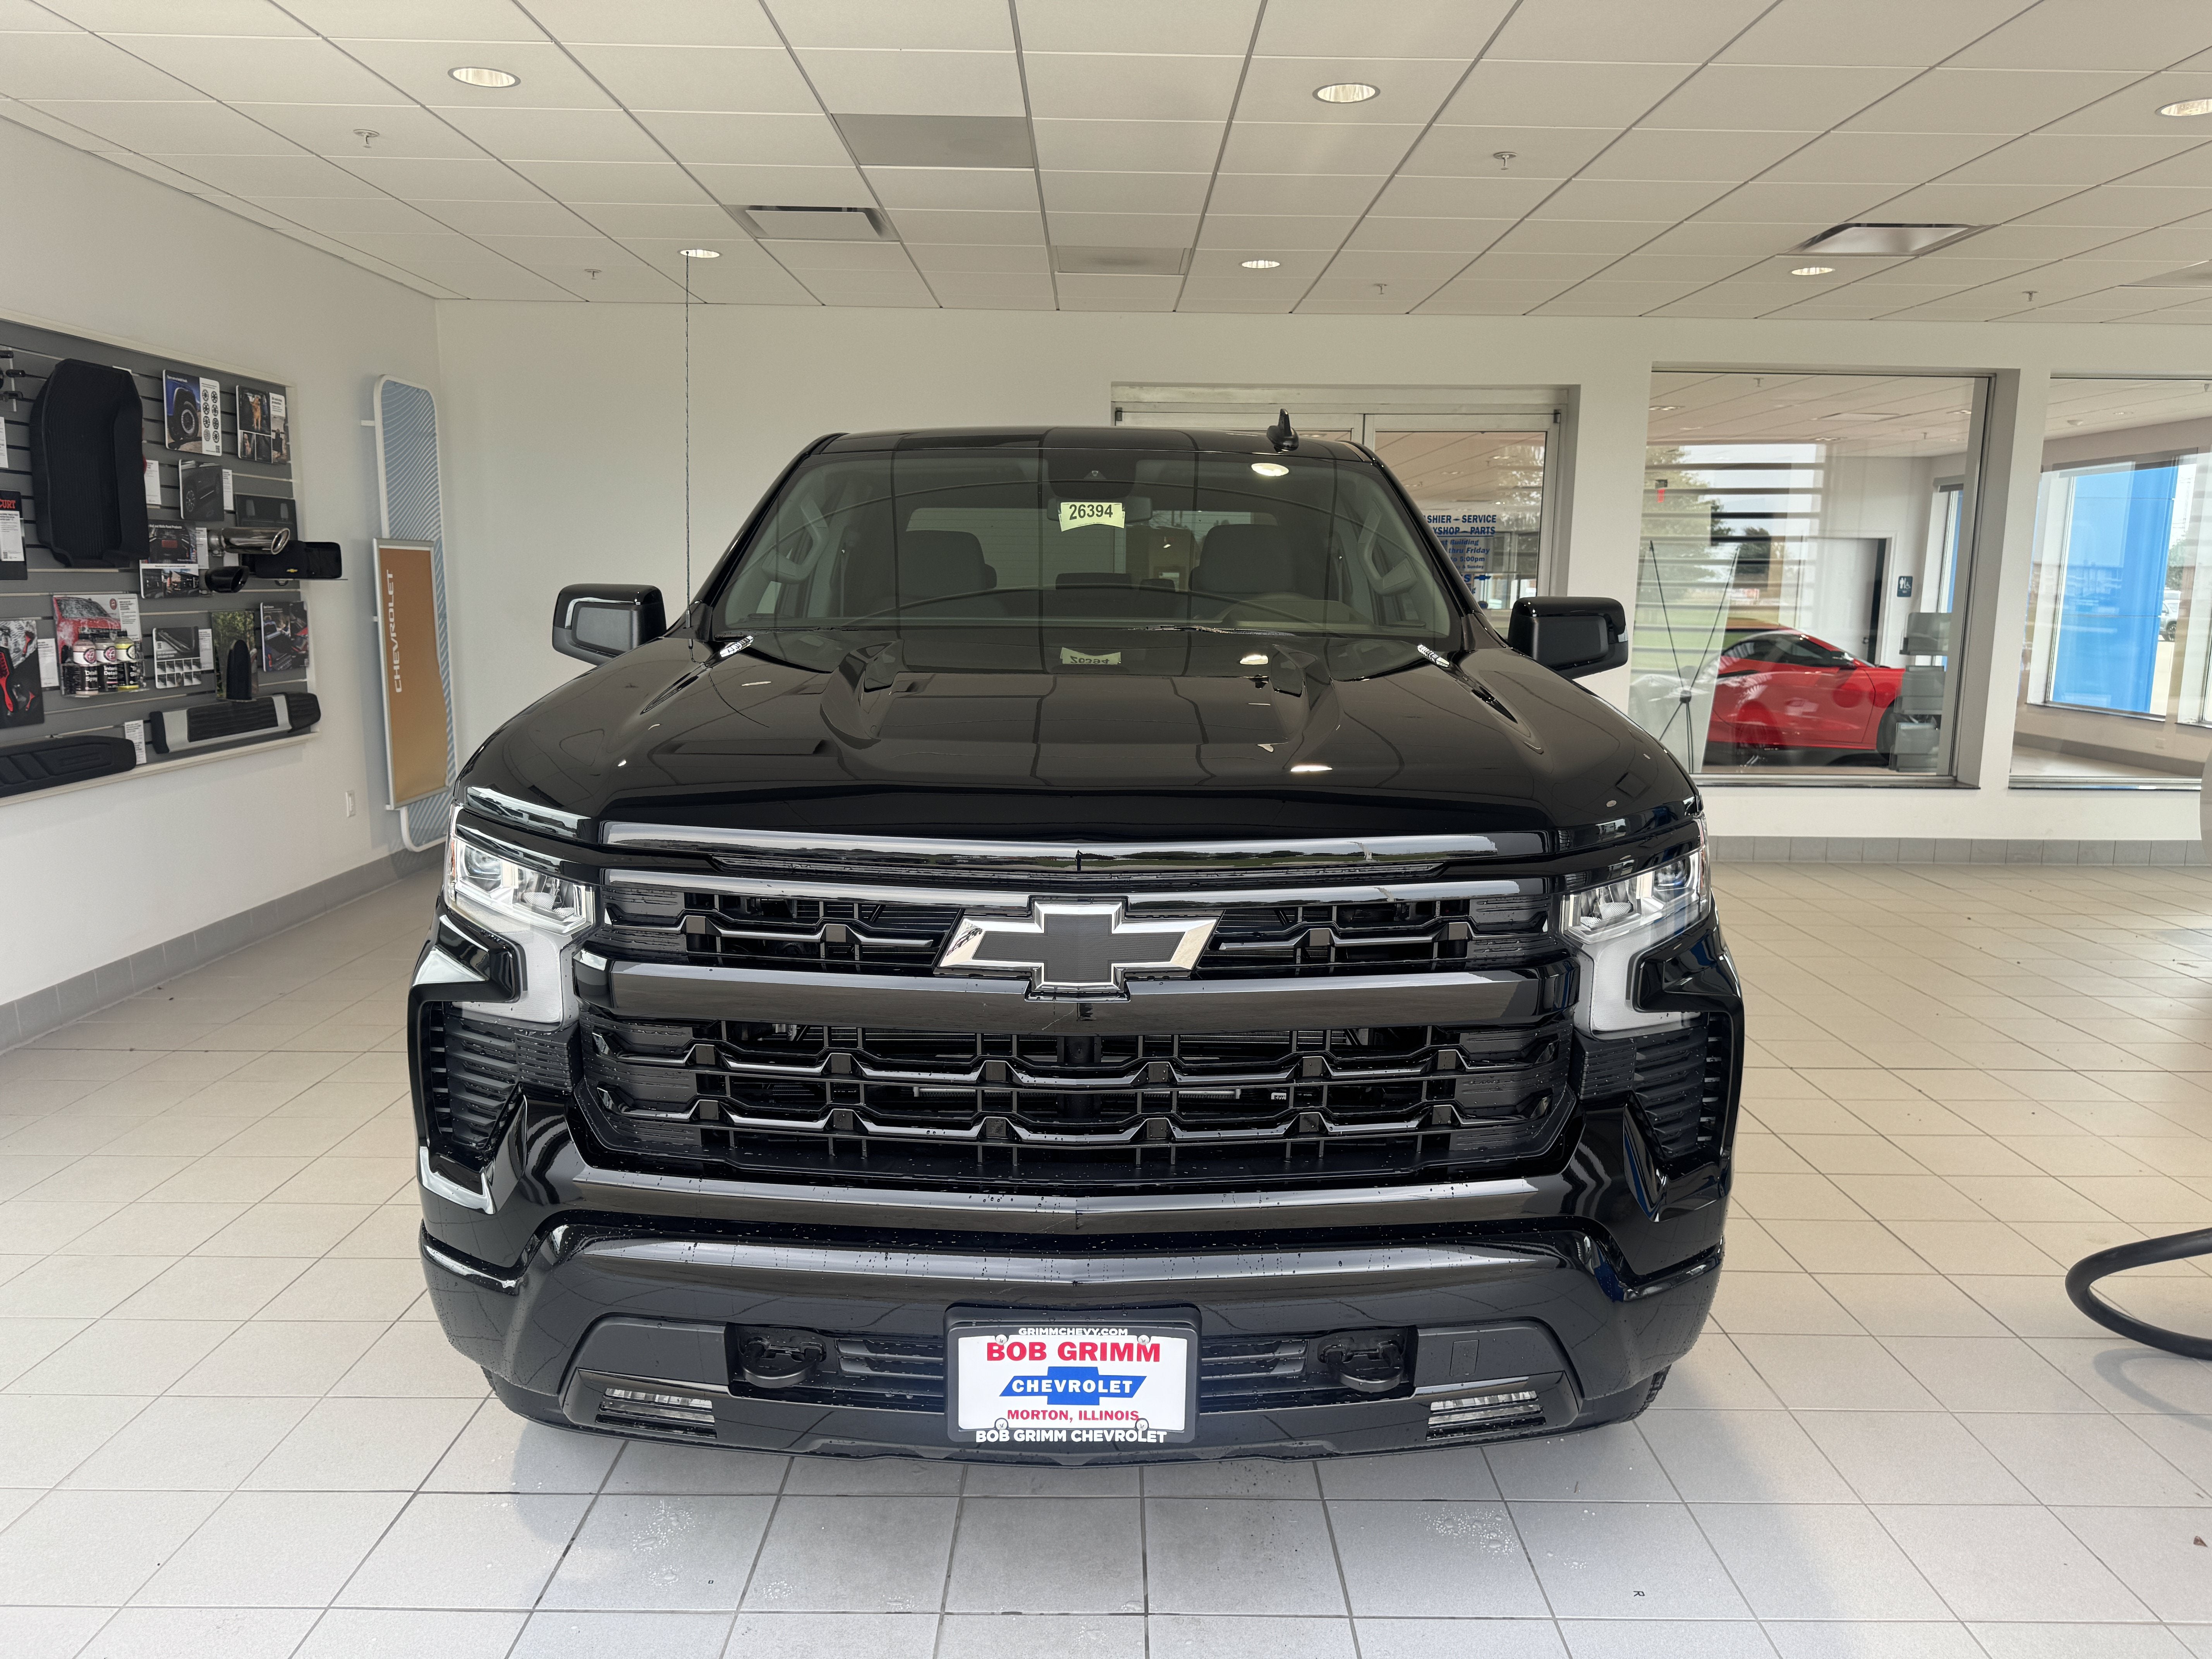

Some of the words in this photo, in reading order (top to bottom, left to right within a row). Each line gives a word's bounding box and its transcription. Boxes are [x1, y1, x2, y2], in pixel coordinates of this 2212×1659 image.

[1069, 504, 1113, 520] 26394
[1424, 515, 1451, 523] SHIER
[387, 569, 402, 692] CHEVROLET
[987, 1342, 1046, 1361] BOB
[1058, 1342, 1160, 1362] GRIMM
[1012, 1379, 1132, 1393] CHEVROLET
[1008, 1410, 1073, 1423] MORTON,
[1079, 1410, 1139, 1421] ILLINOIS
[976, 1430, 1010, 1443] BOB
[1013, 1429, 1066, 1442] GRIMM
[1071, 1430, 1167, 1443] CHEVROLET
